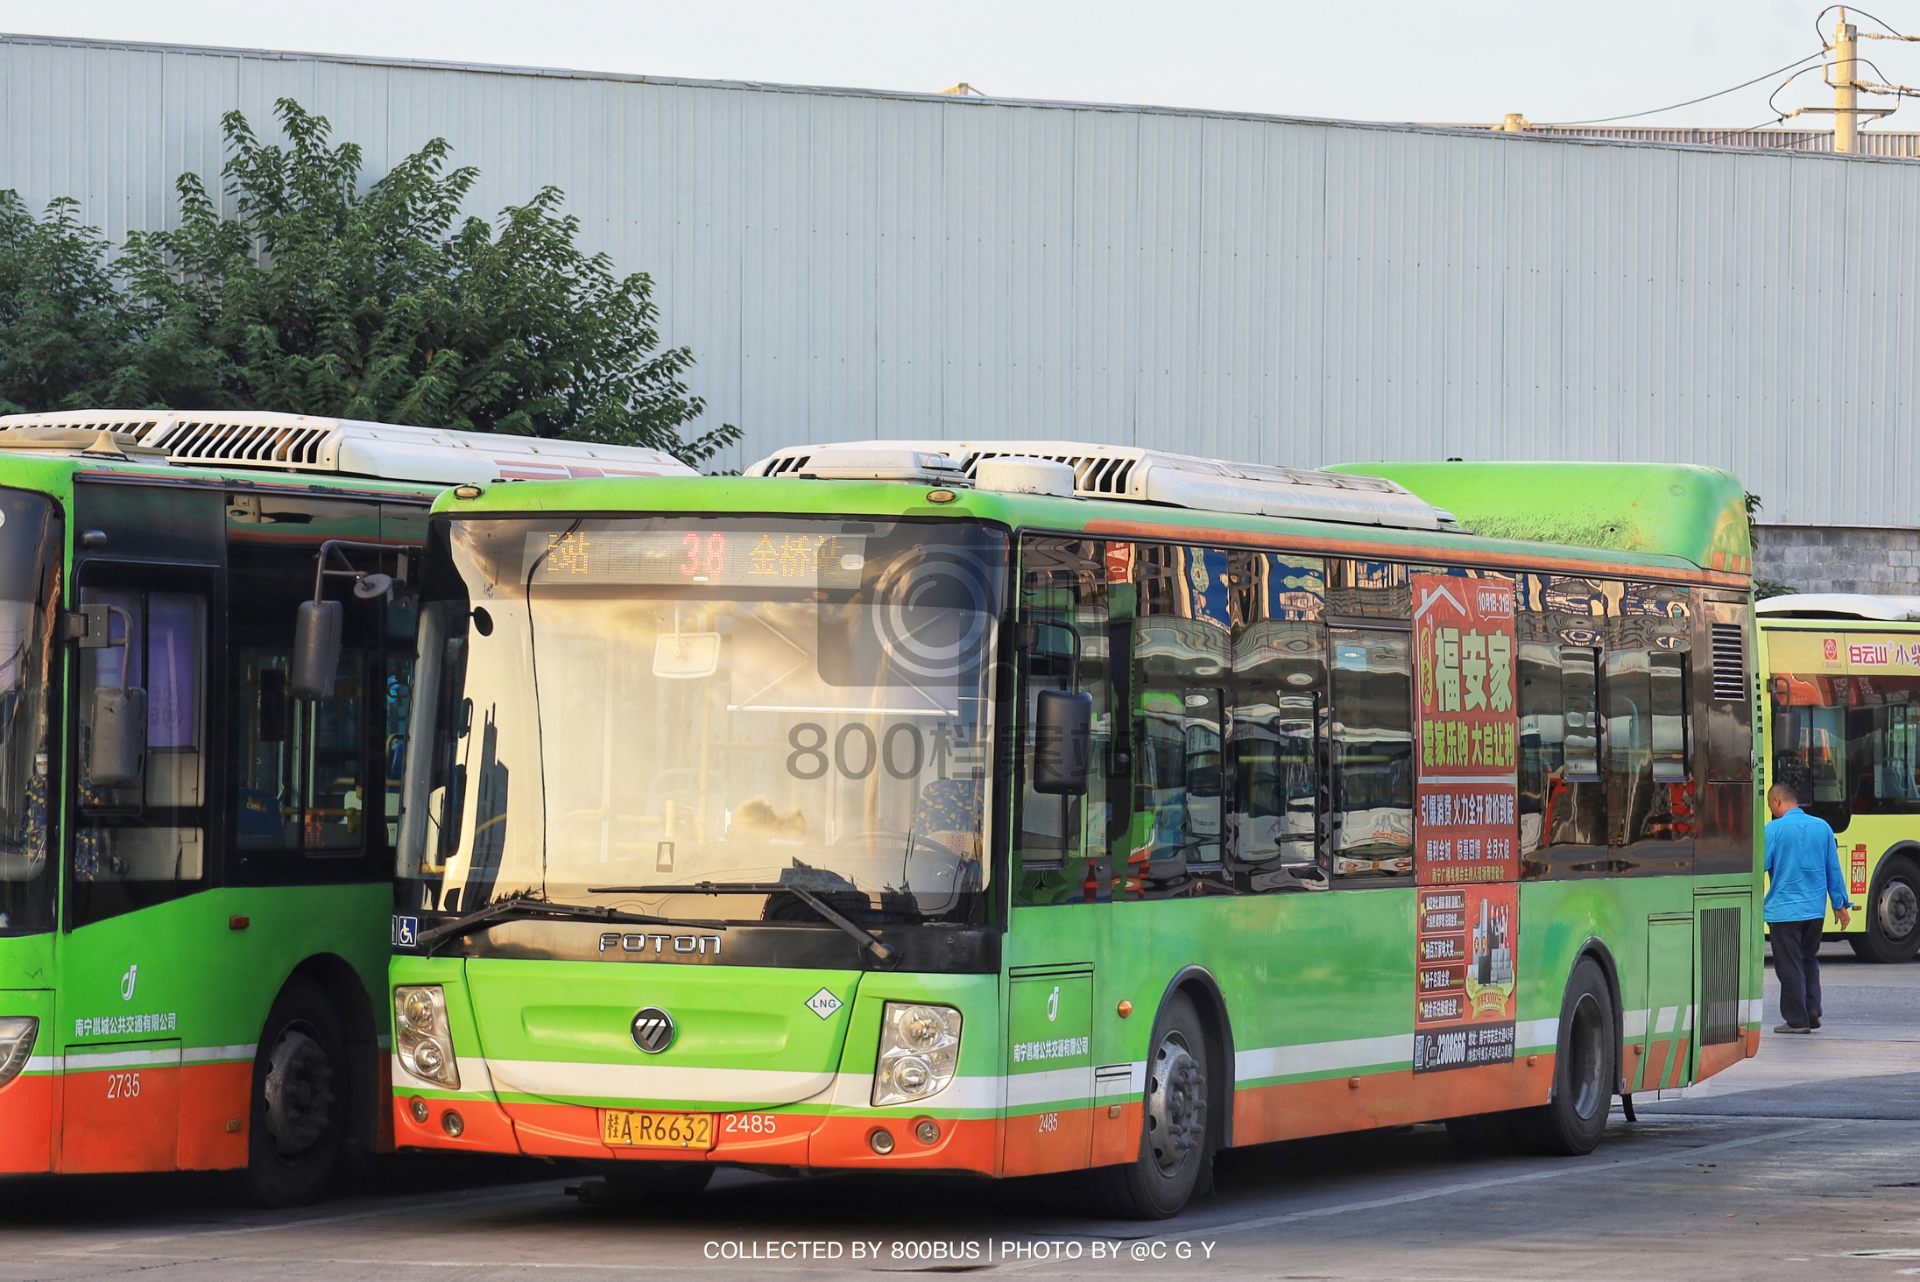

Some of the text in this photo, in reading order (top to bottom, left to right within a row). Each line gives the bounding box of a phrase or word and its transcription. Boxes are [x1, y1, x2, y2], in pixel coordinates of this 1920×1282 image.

[681, 532, 725, 576] 38
[748, 534, 844, 577] 金桥站
[1848, 644, 1888, 665] 白云山
[1435, 626, 1513, 713] 福安家
[1421, 793, 1514, 826] 引爆消费 火力全开 放价到底
[1486, 837, 1510, 860] 全月大促
[1852, 866, 1865, 883] 500
[600, 932, 722, 955] FOTON
[811, 998, 837, 1009] LNG
[75, 1012, 177, 1037] 南宁邕城公共交通有限公司
[107, 1073, 141, 1099] 2735
[725, 1113, 777, 1134] 2485
[1038, 1113, 1059, 1133] 2485
